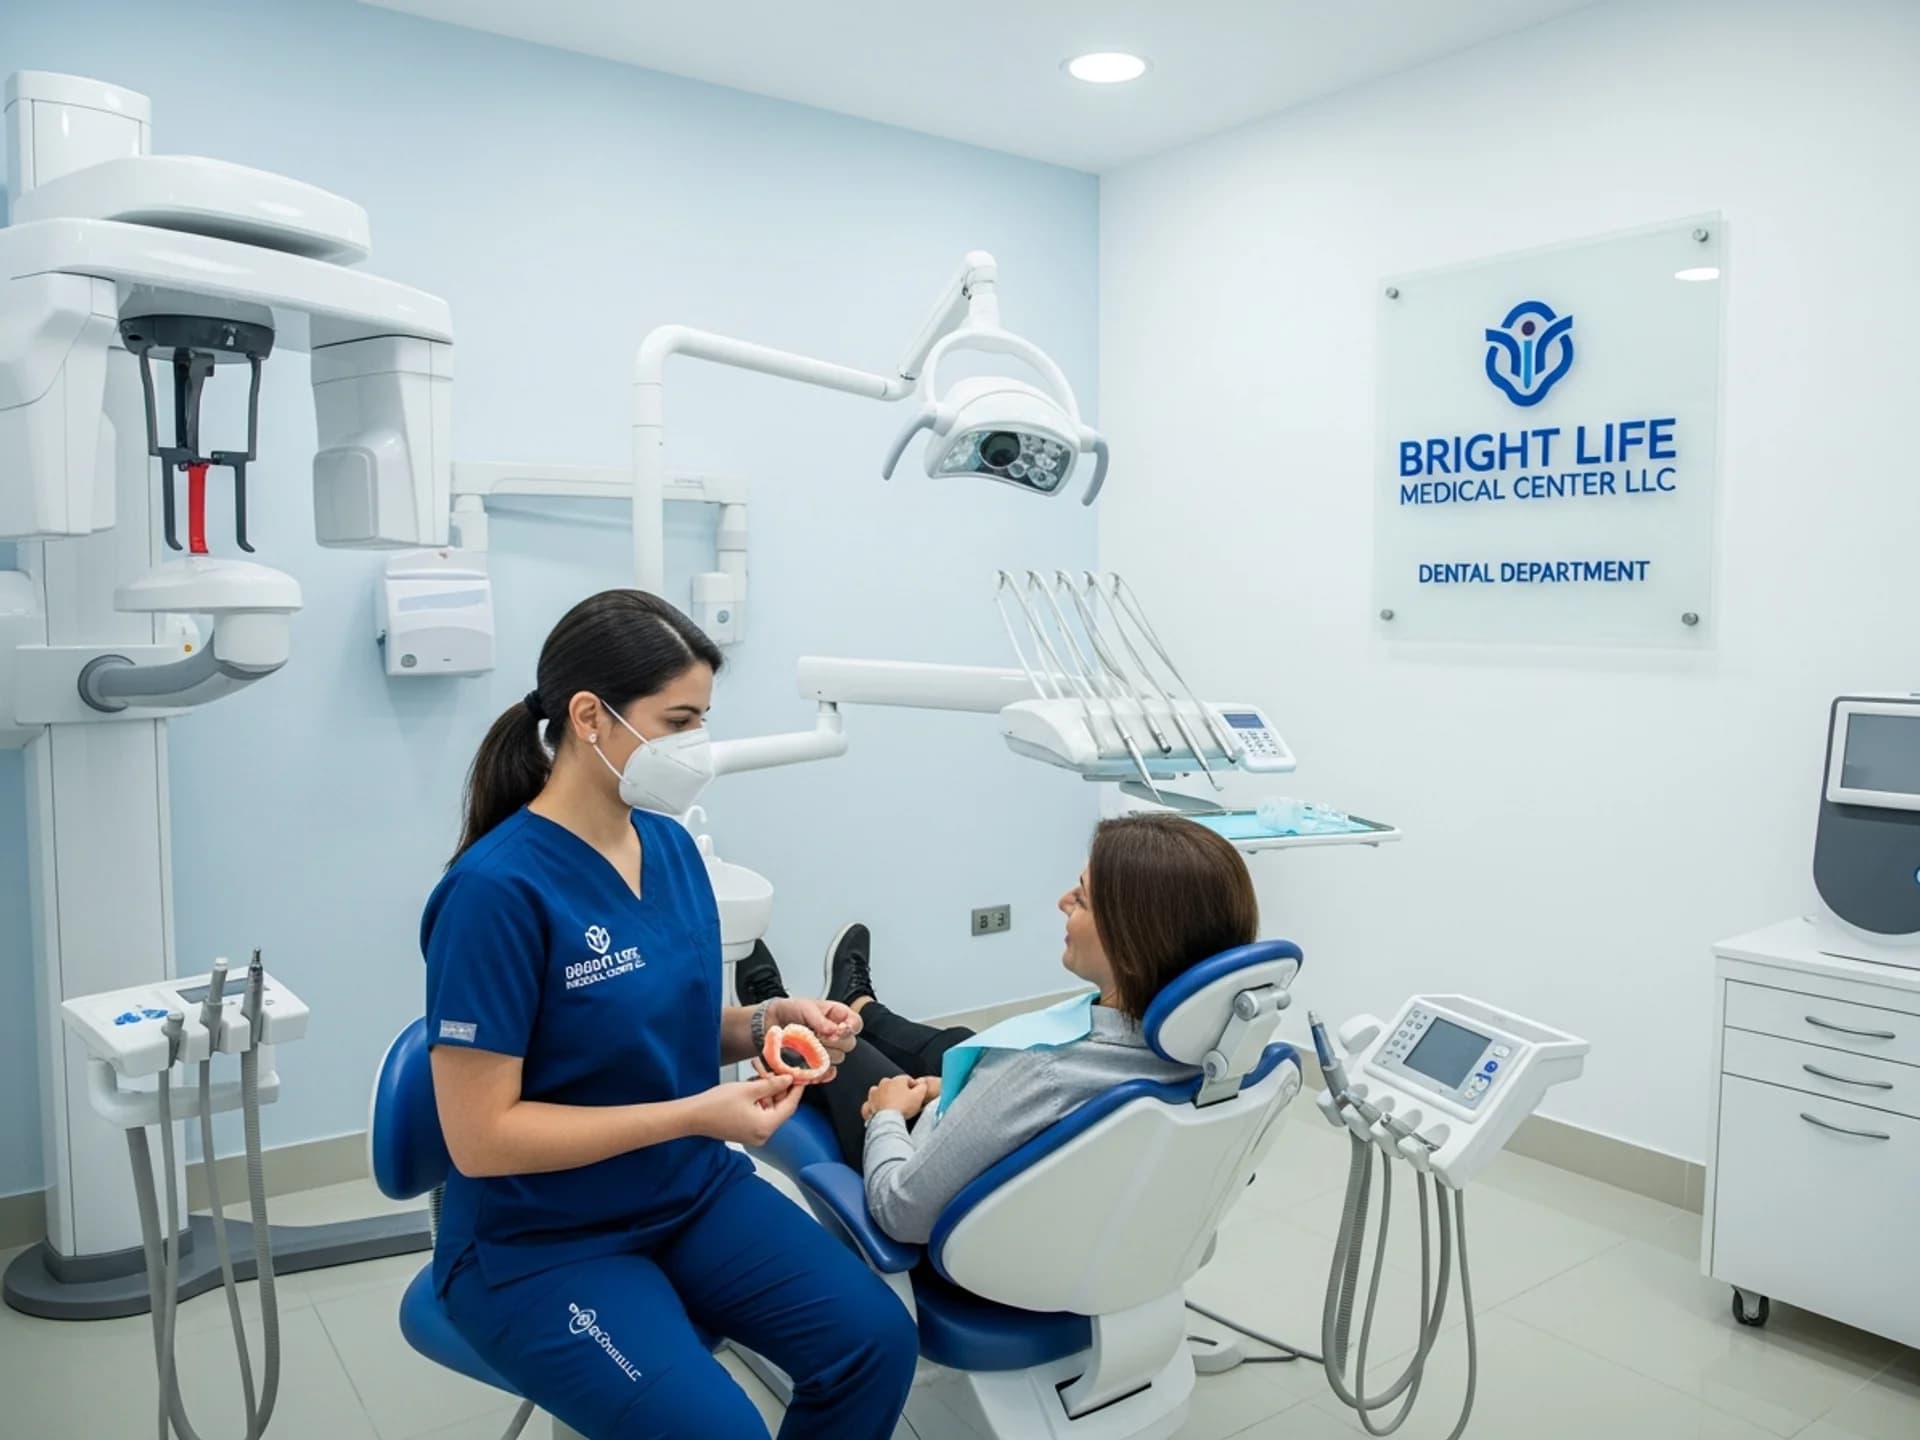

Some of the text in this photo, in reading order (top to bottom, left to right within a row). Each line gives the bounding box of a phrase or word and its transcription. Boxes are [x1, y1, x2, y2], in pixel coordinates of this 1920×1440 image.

[1399, 418, 1677, 477] BRIGHT LIFE
[1400, 467, 1677, 506] MEDICAL CENTER LLC
[1418, 560, 1651, 584] DENTAL DEPARTMENT
